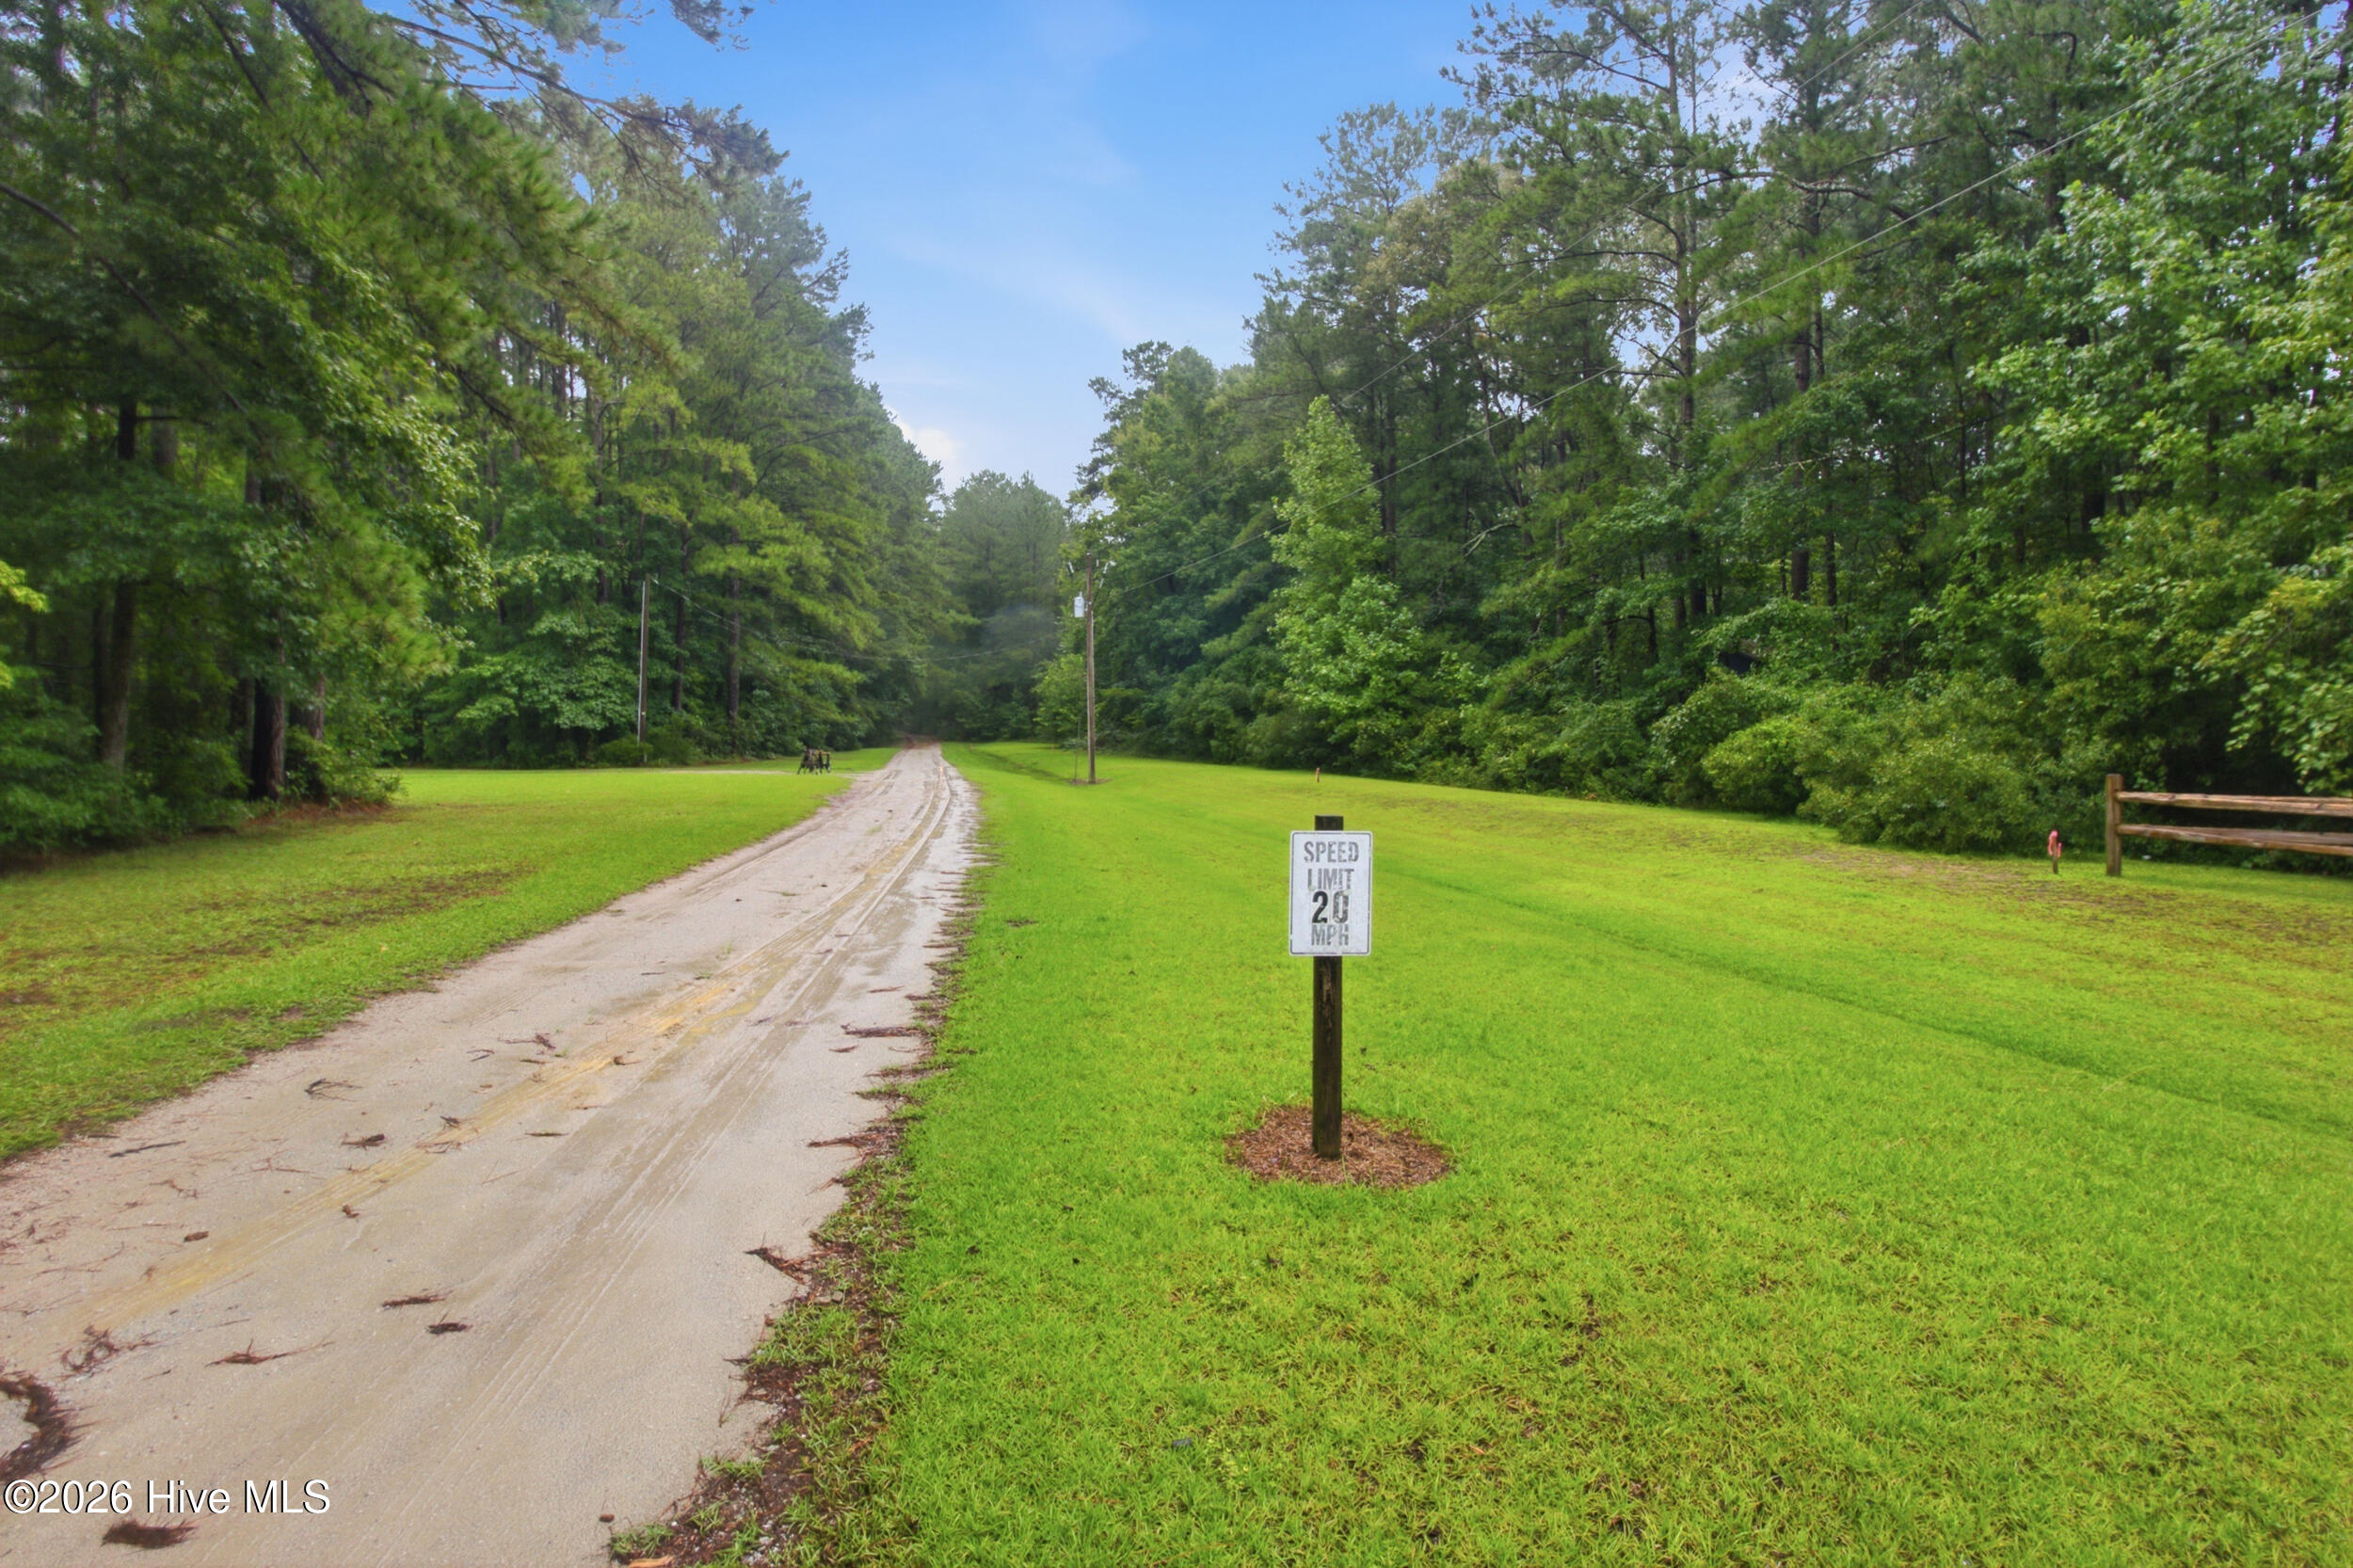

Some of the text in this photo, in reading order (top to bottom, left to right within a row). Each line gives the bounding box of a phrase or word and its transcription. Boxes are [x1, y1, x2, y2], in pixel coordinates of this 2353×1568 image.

[1304, 841, 1359, 863] SPEED
[1307, 868, 1354, 890] LIMIT
[1311, 890, 1350, 923] 20
[1311, 924, 1349, 946] MPH
